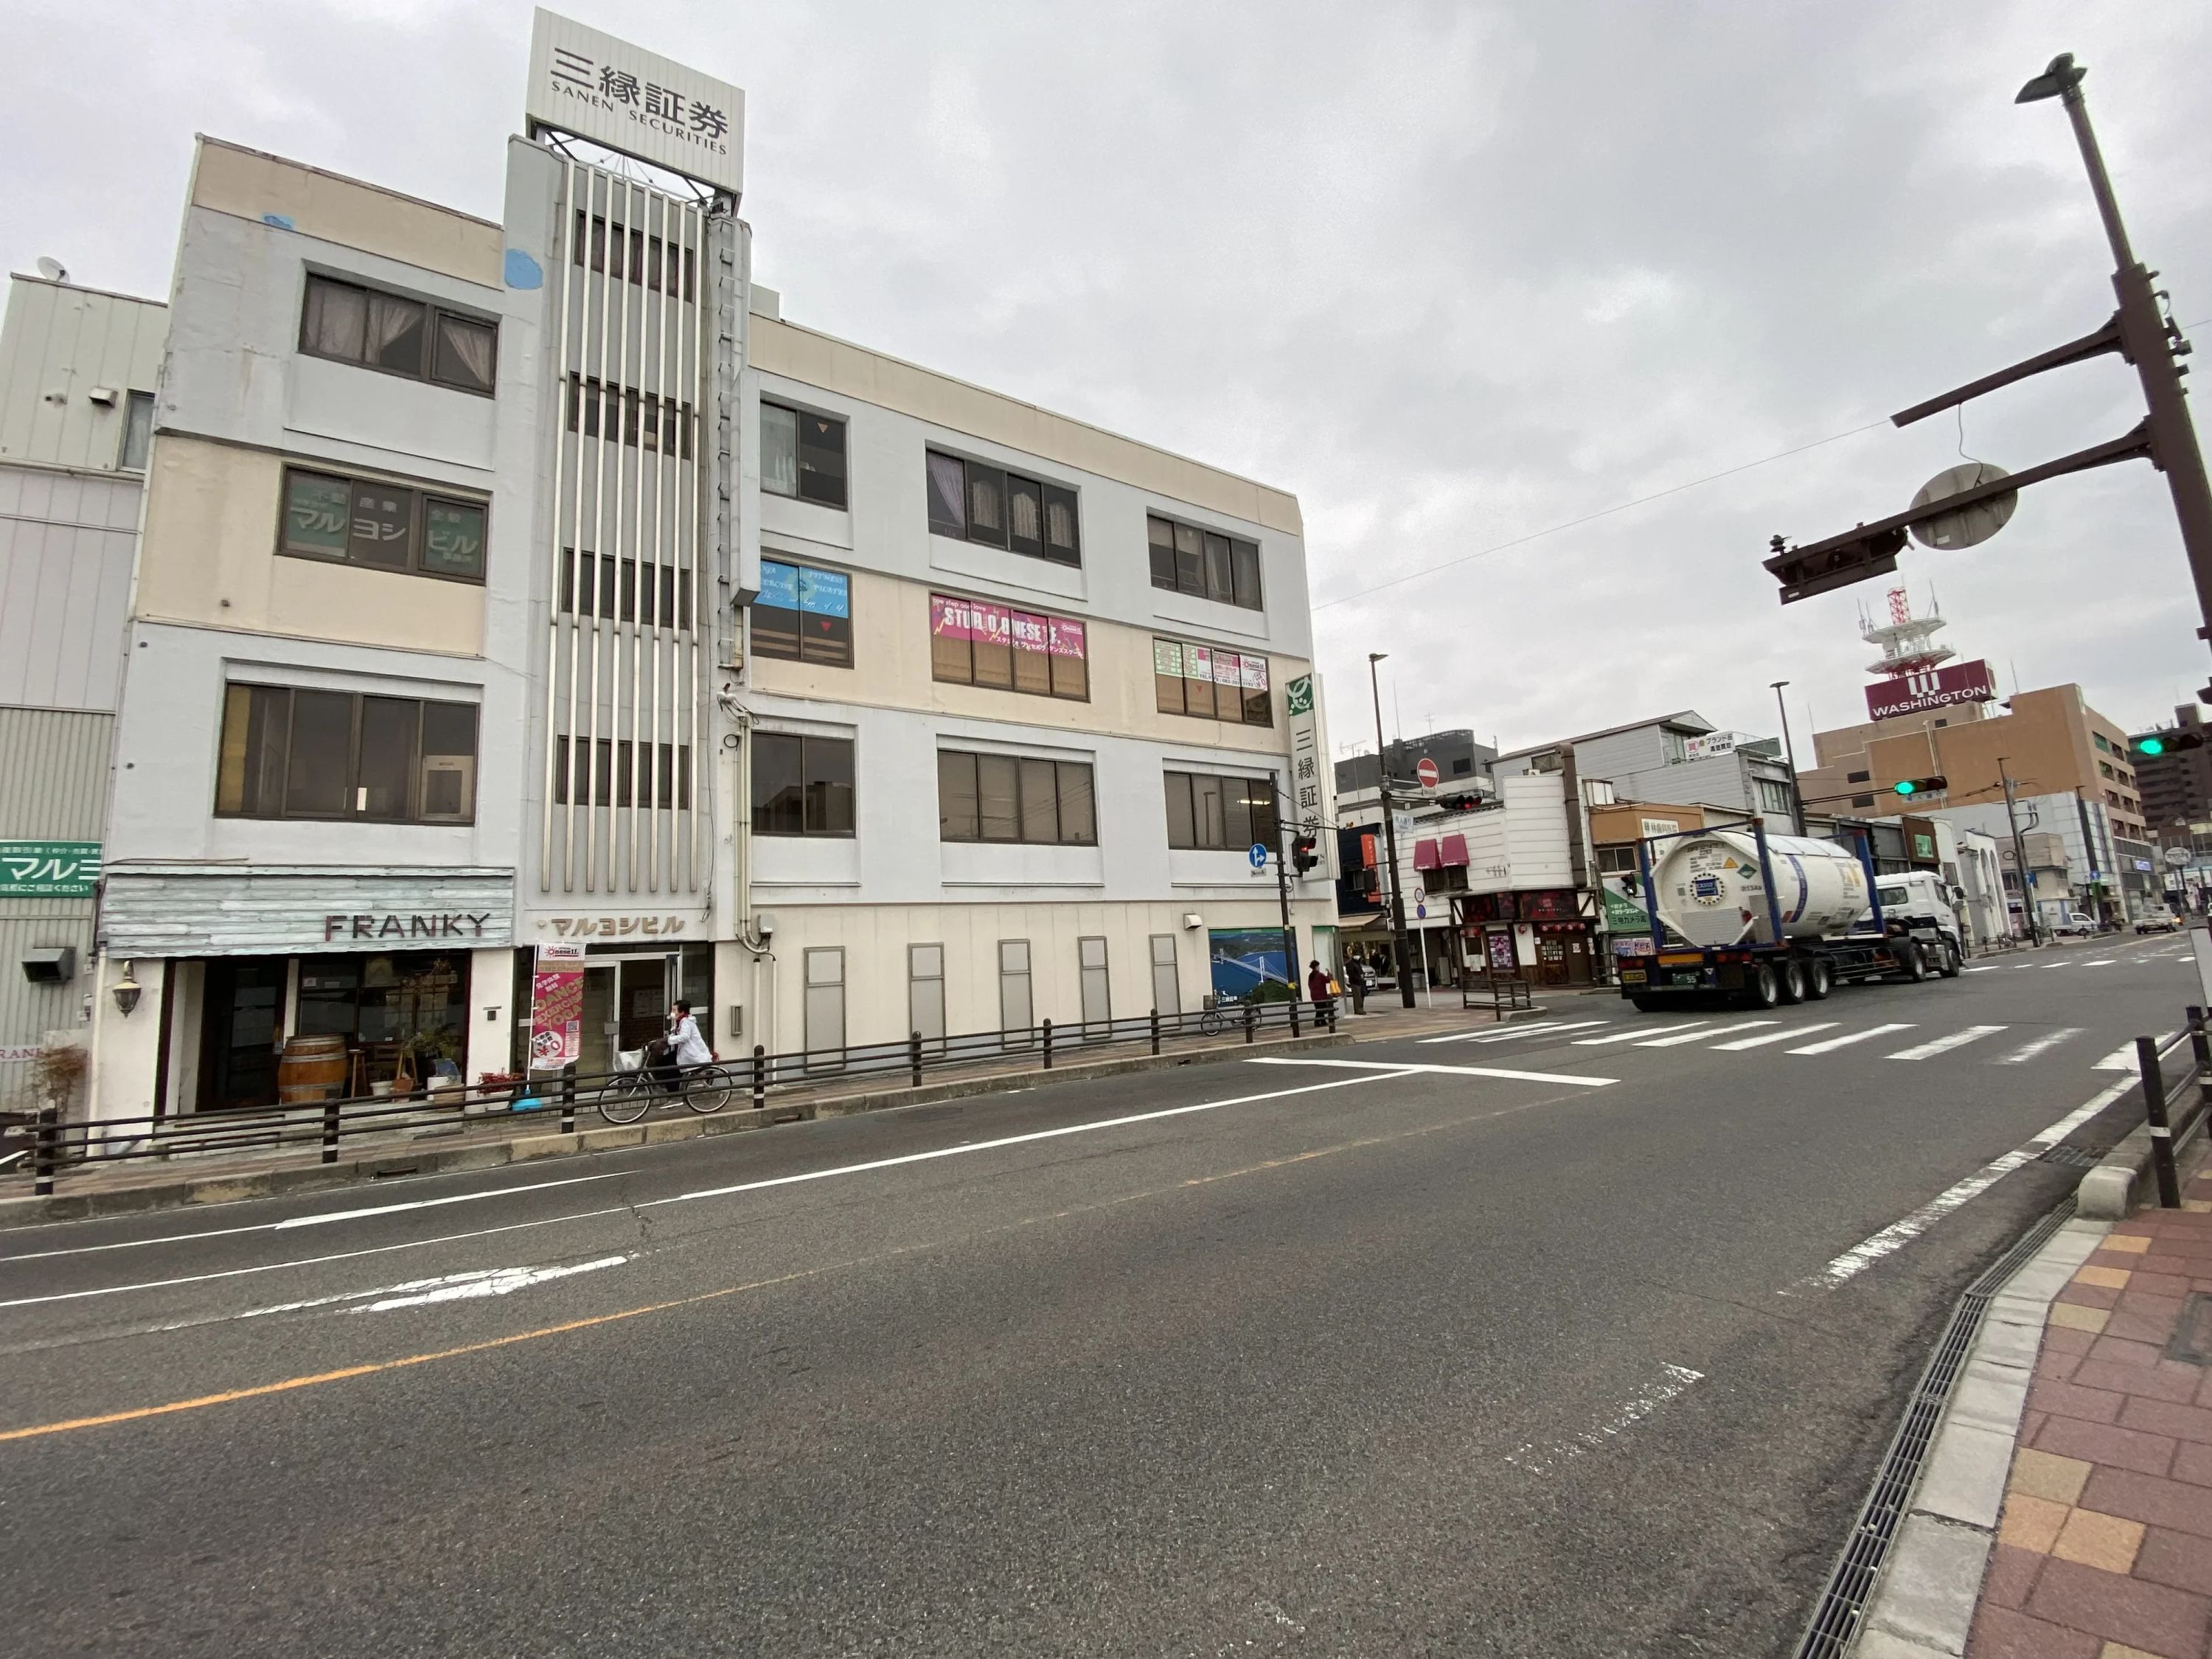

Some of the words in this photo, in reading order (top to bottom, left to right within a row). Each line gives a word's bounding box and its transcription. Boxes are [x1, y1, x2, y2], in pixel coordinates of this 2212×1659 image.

[550, 47, 728, 139] 三縁証券
[552, 81, 613, 112] SANEN
[629, 110, 726, 155] SECURITIES
[1873, 685, 1986, 717] WASHINGTON
[1295, 728, 1320, 838] 三縁証券
[324, 914, 490, 942] FRANKY
[552, 917, 685, 936] マルヨシビル
